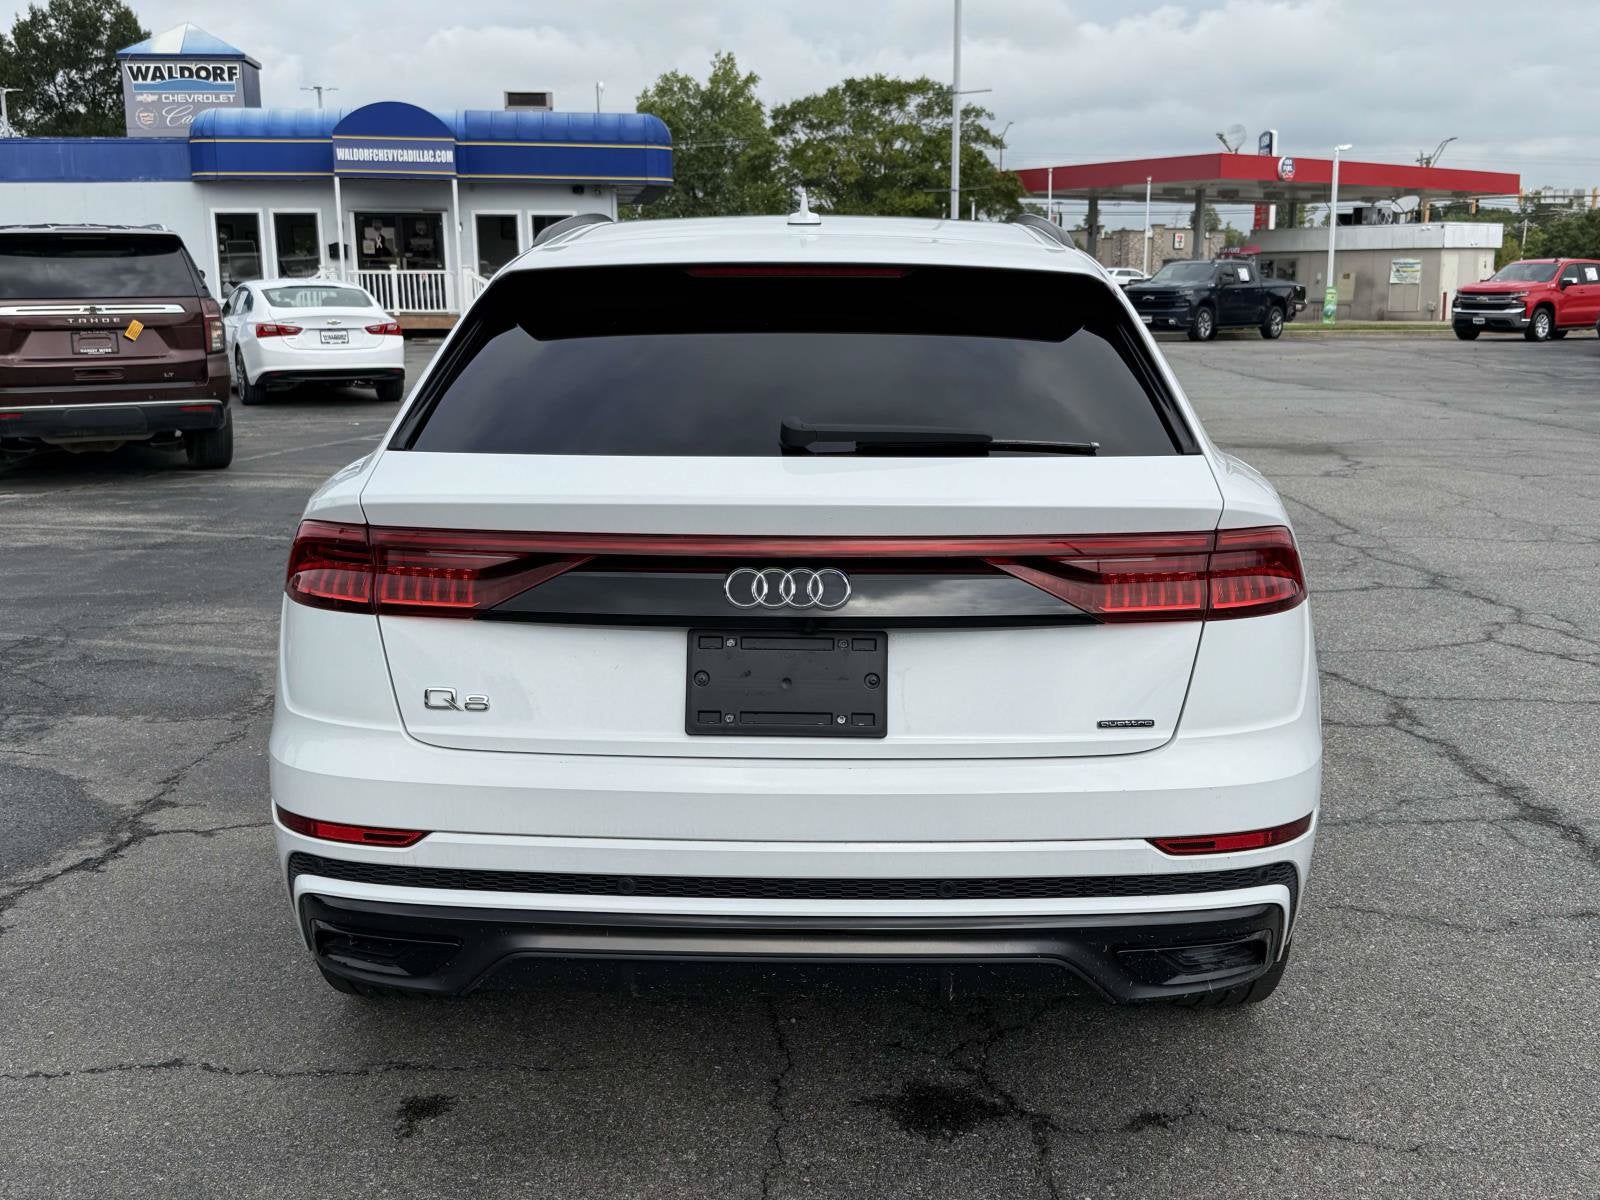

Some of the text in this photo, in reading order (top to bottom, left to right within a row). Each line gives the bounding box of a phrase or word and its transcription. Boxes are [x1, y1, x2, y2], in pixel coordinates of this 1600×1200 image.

[126, 65, 239, 82] WALDORF
[162, 94, 235, 103] CHEVROLET
[336, 148, 454, 163] WALDORFCHEVYCADILLAC.COM
[424, 687, 490, 712] Q8
[1100, 720, 1153, 728] quattro
